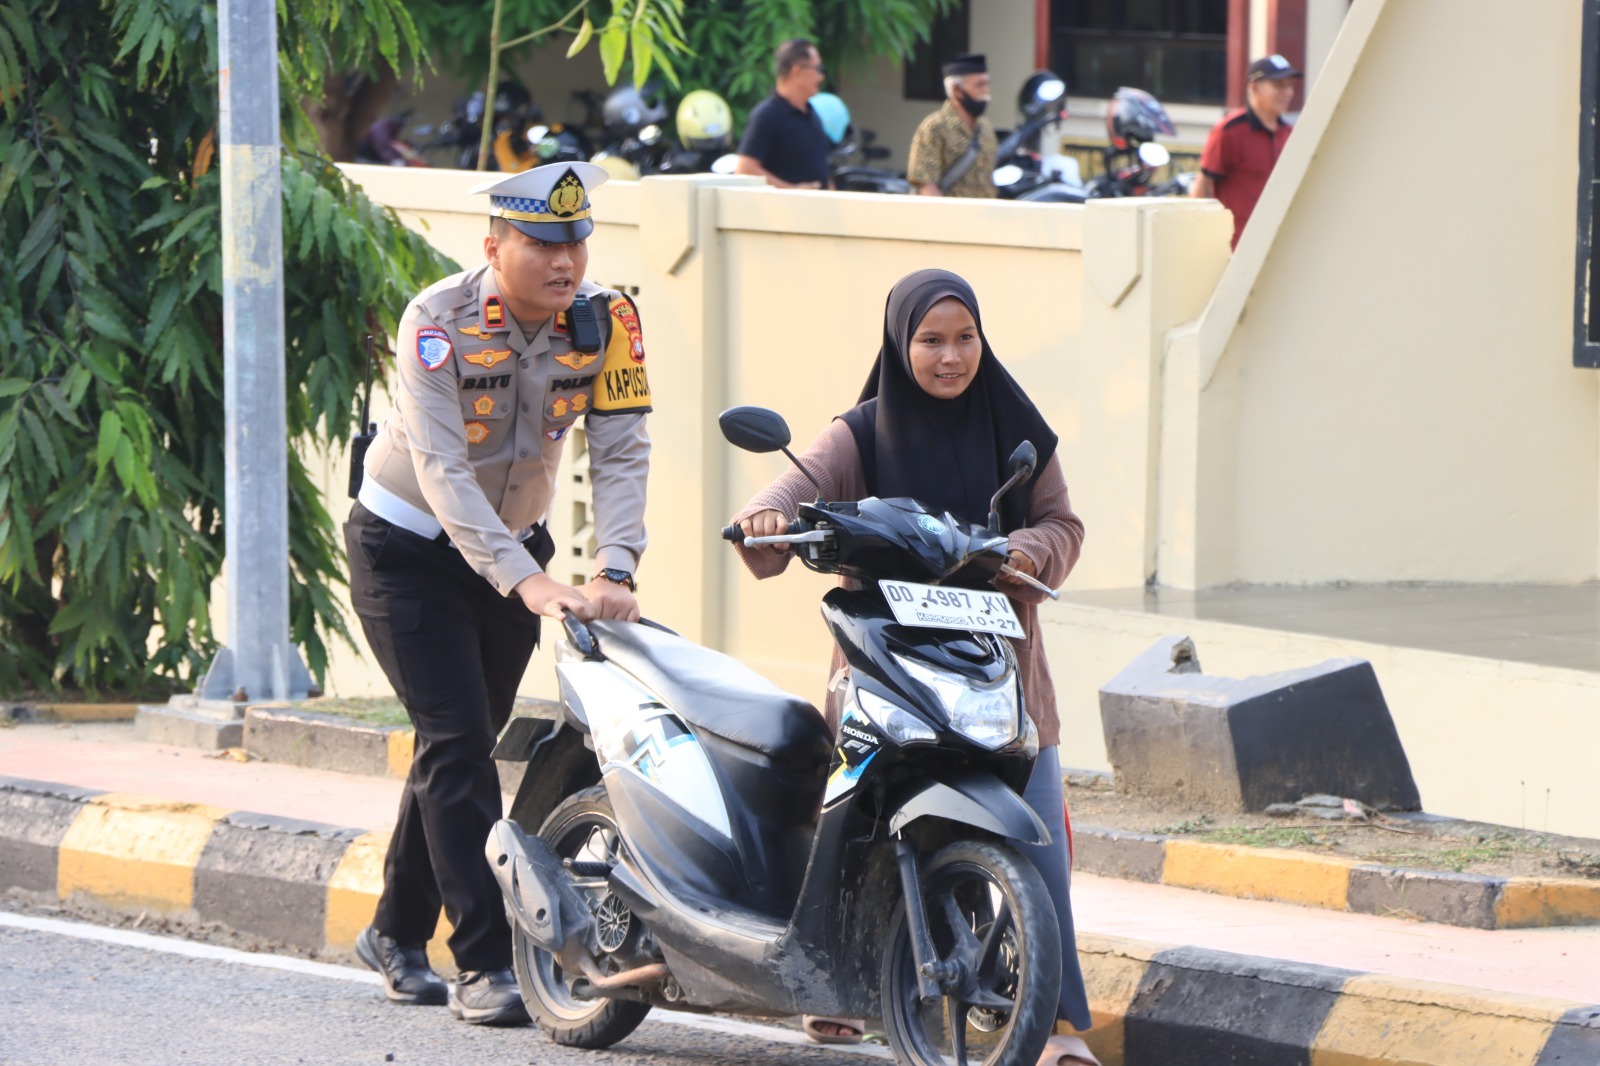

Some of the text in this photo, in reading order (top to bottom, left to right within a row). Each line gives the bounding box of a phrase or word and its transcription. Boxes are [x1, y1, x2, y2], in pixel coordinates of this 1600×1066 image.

[462, 374, 512, 389] BAYU
[886, 584, 1009, 613] DD 4987 KV
[843, 725, 879, 745] HONDA
